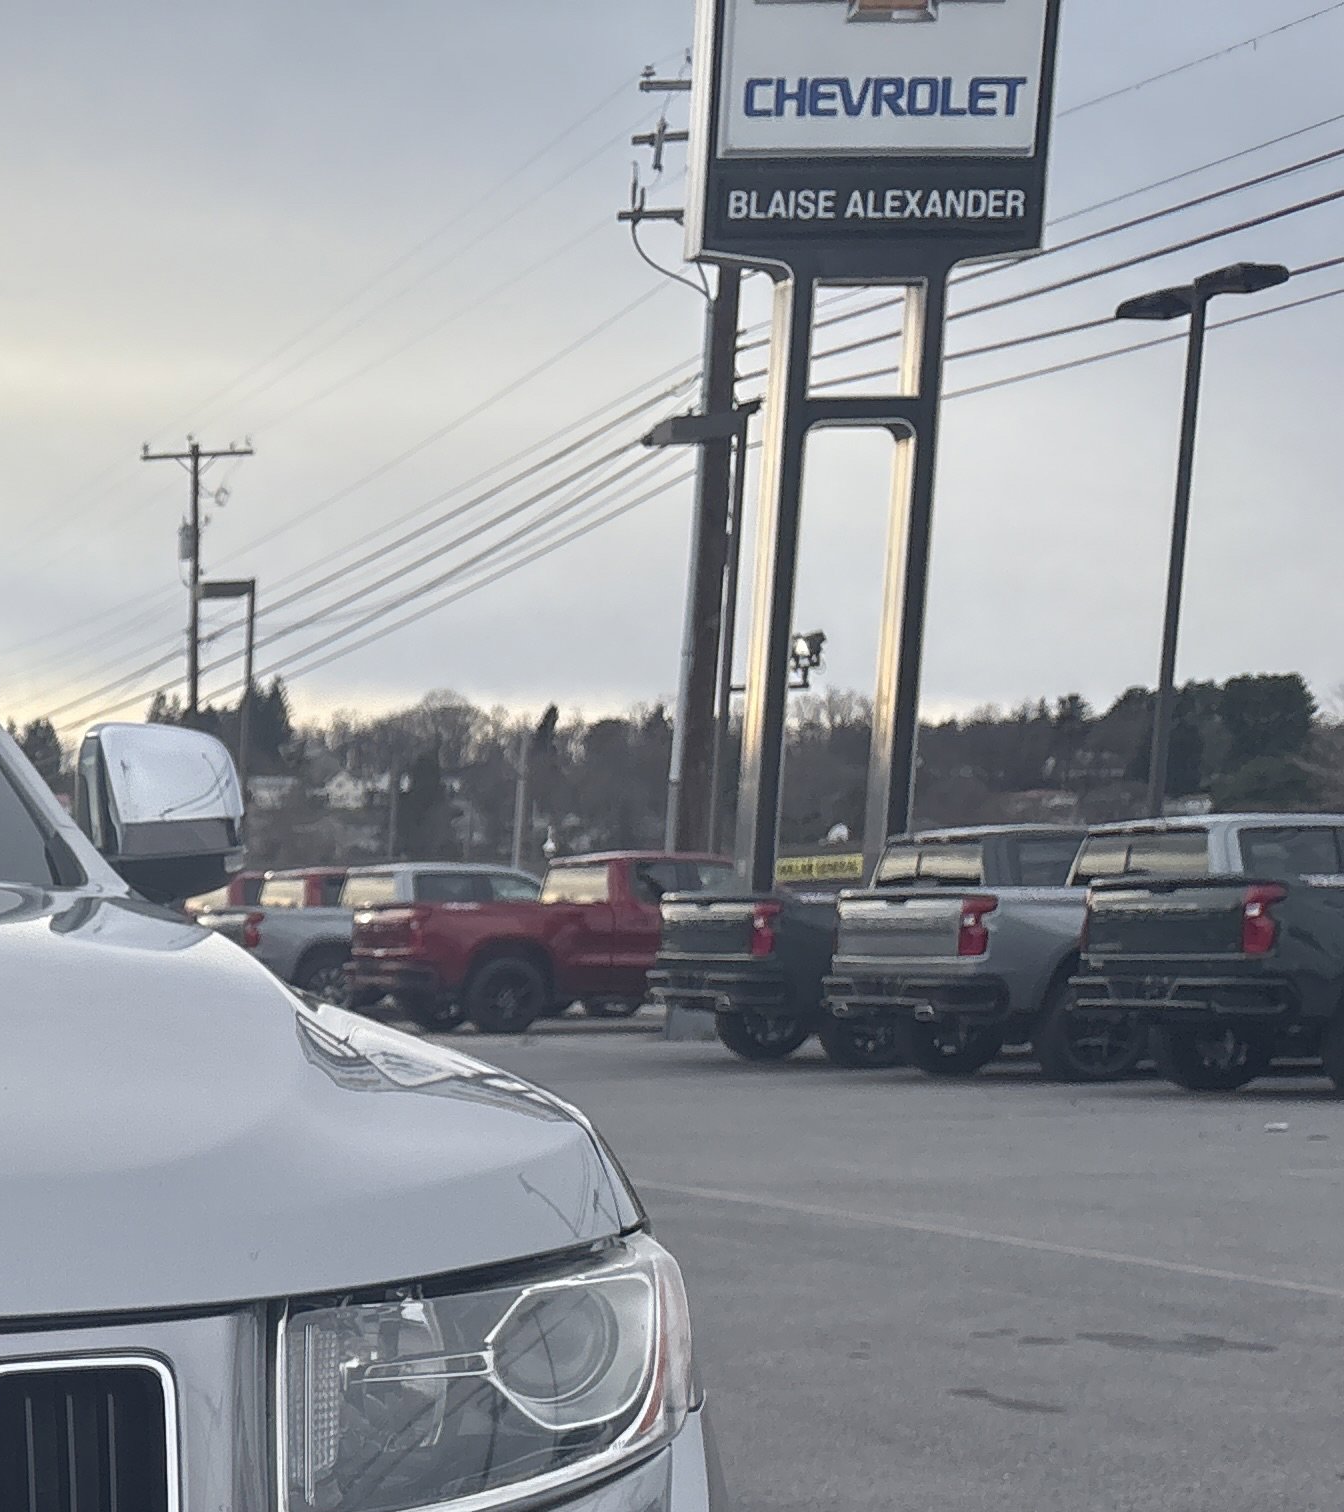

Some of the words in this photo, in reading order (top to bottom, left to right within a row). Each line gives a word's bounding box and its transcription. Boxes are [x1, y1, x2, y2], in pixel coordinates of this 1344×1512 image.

[743, 76, 1027, 118] CHEVROLET
[728, 189, 835, 219] BLAISE
[845, 190, 1025, 218] ALEXANDER
